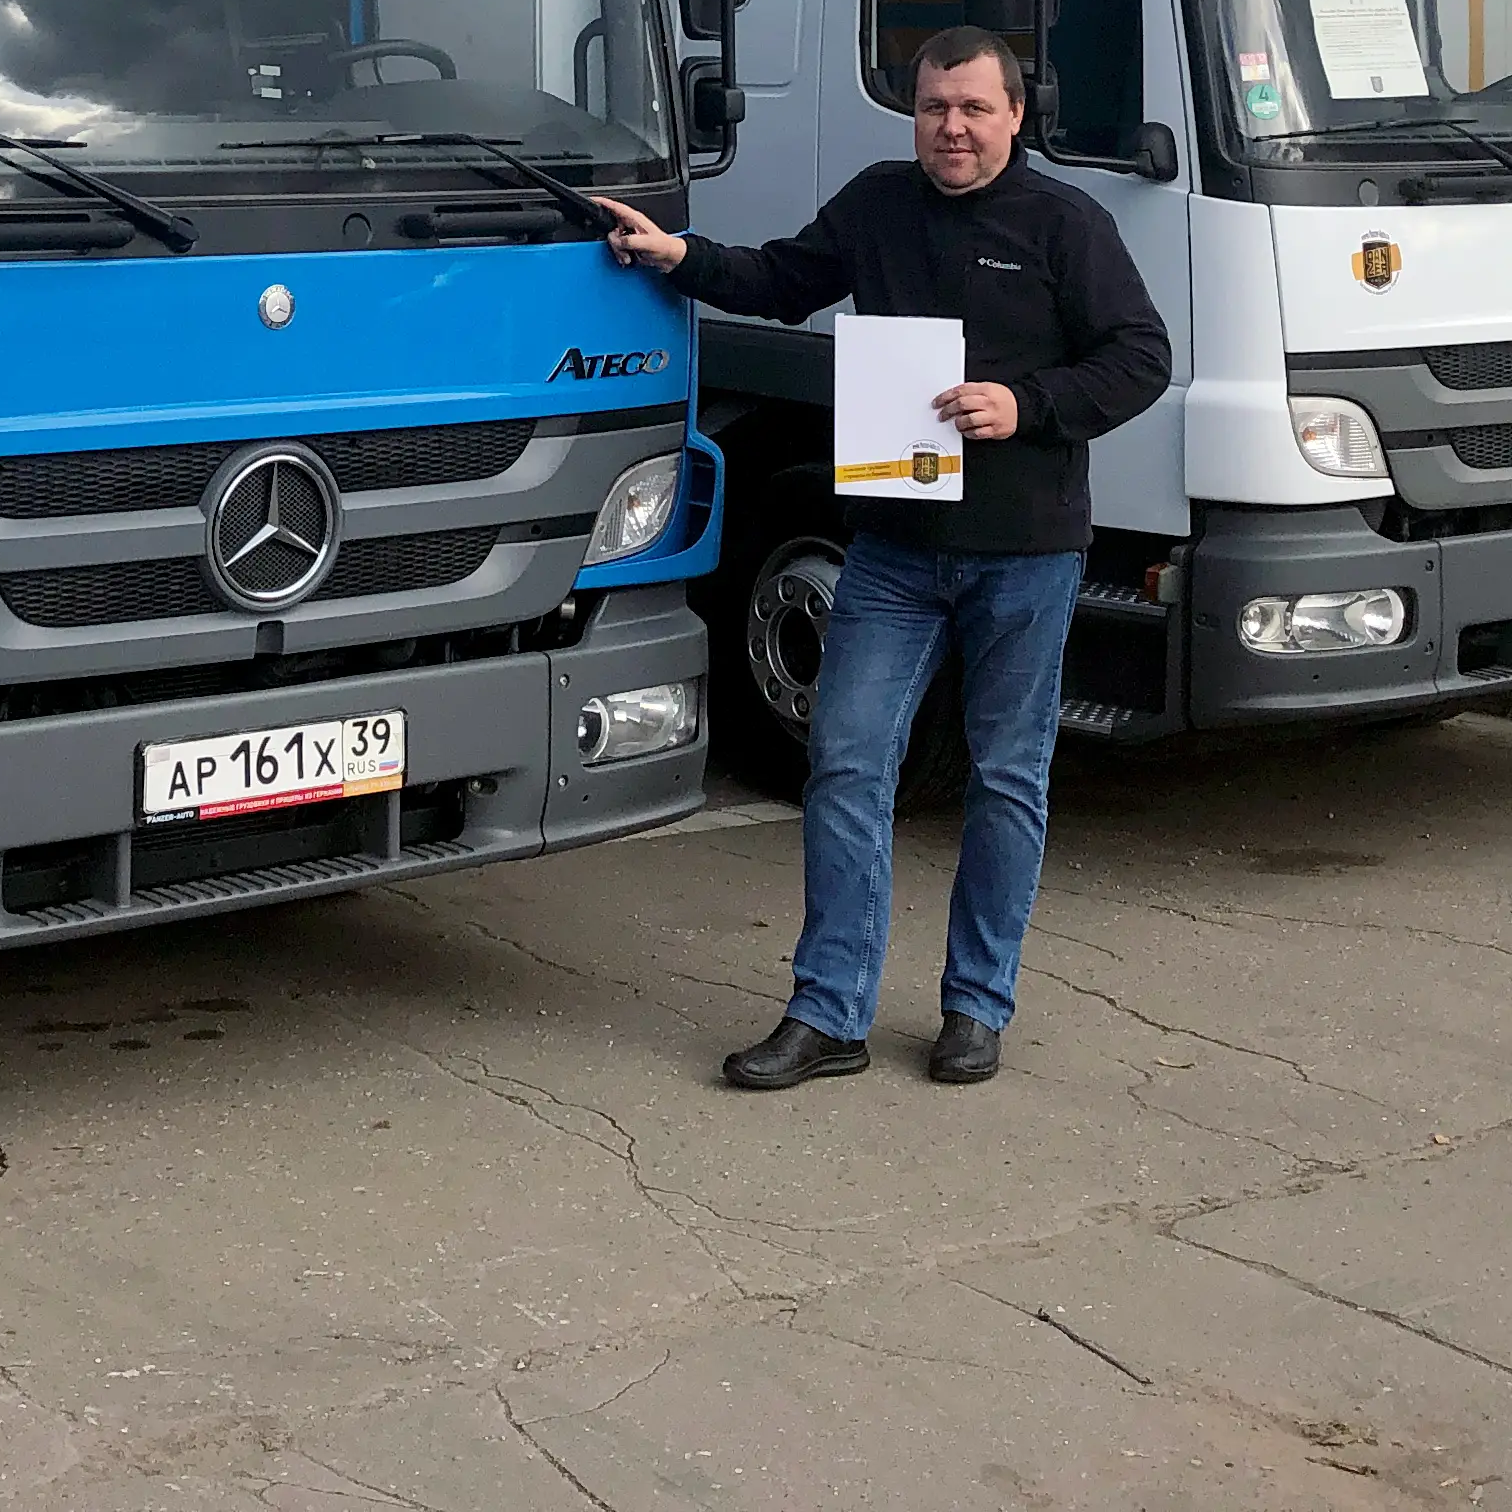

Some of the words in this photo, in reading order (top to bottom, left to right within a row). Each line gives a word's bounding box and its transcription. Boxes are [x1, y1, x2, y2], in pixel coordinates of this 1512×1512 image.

[1258, 86, 1269, 101] 4
[987, 258, 1021, 270] Columbia
[544, 347, 670, 383] ATEGO
[351, 718, 391, 757] 39
[348, 759, 377, 776] RUS
[146, 810, 195, 825] PANZER-AUTO
